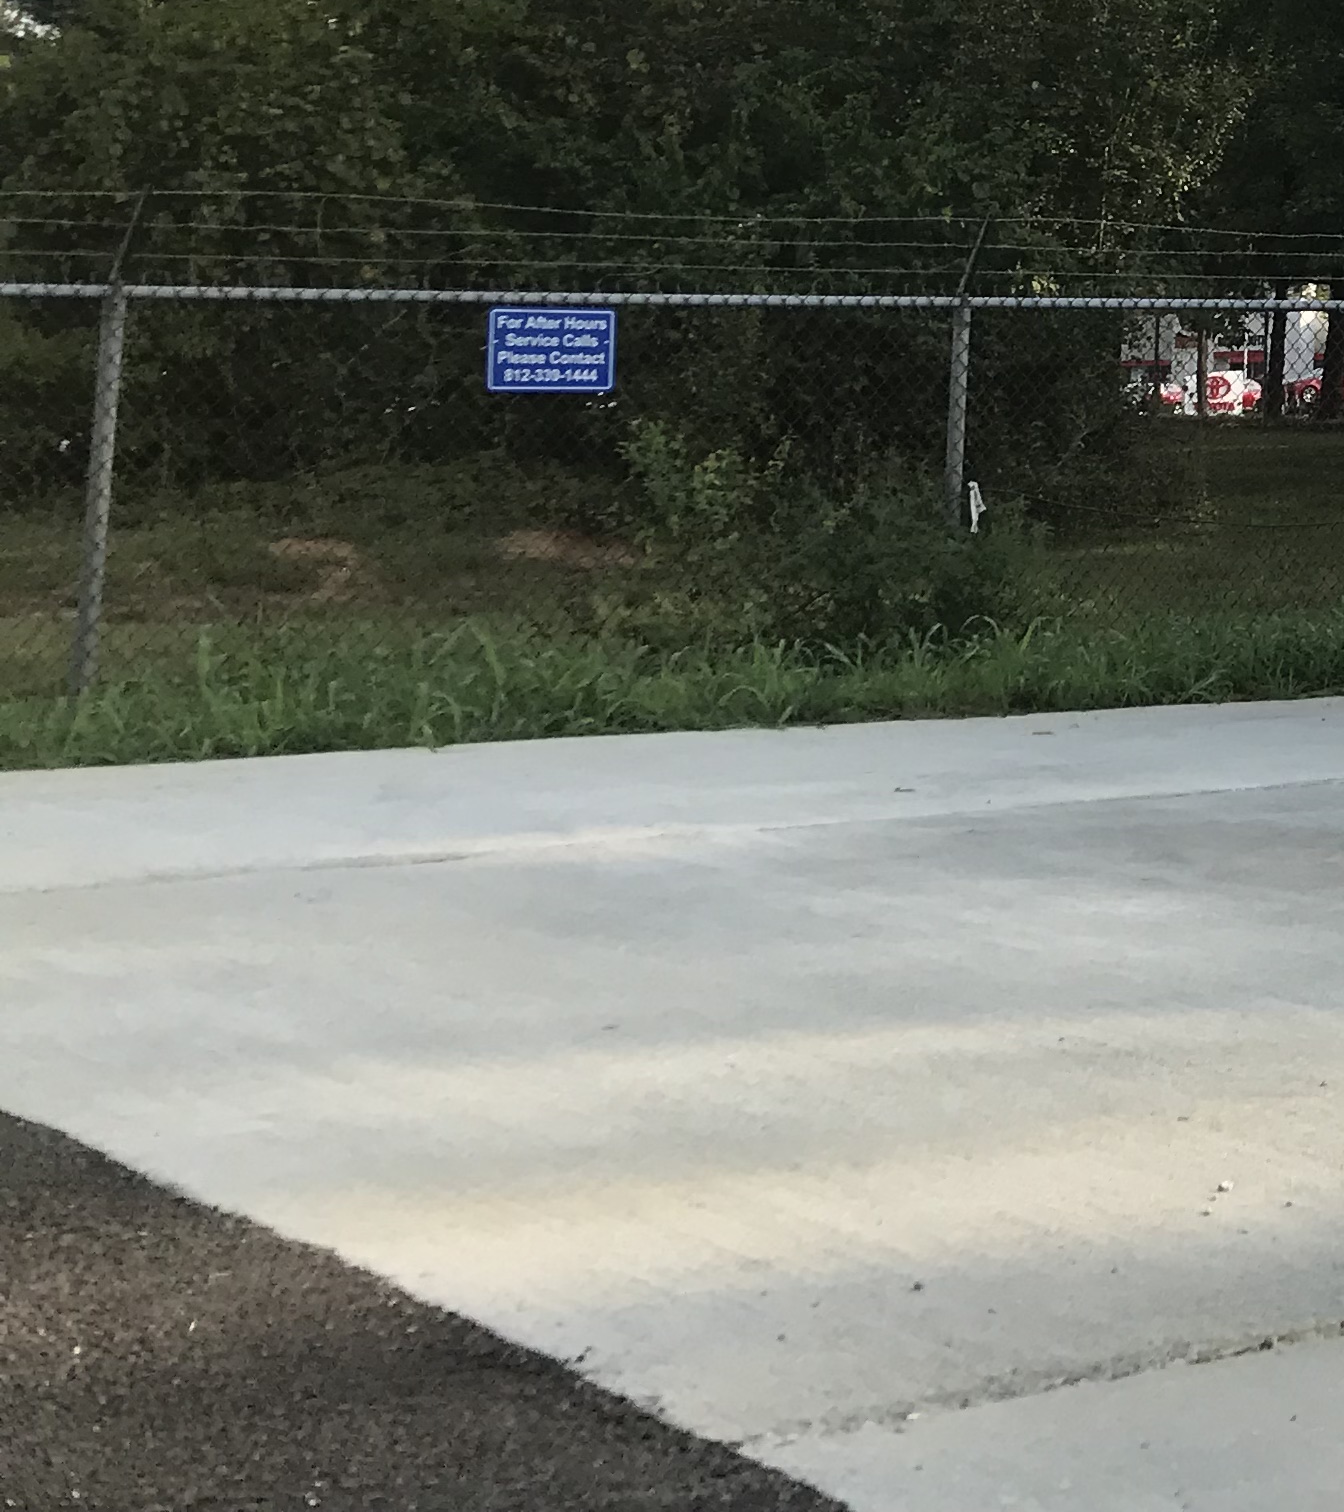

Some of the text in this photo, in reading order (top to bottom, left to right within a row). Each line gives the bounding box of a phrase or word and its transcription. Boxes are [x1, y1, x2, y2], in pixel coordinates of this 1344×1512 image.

[497, 315, 607, 330] For After Hours
[505, 333, 599, 347] Service Calls
[497, 350, 605, 365] Please Contact
